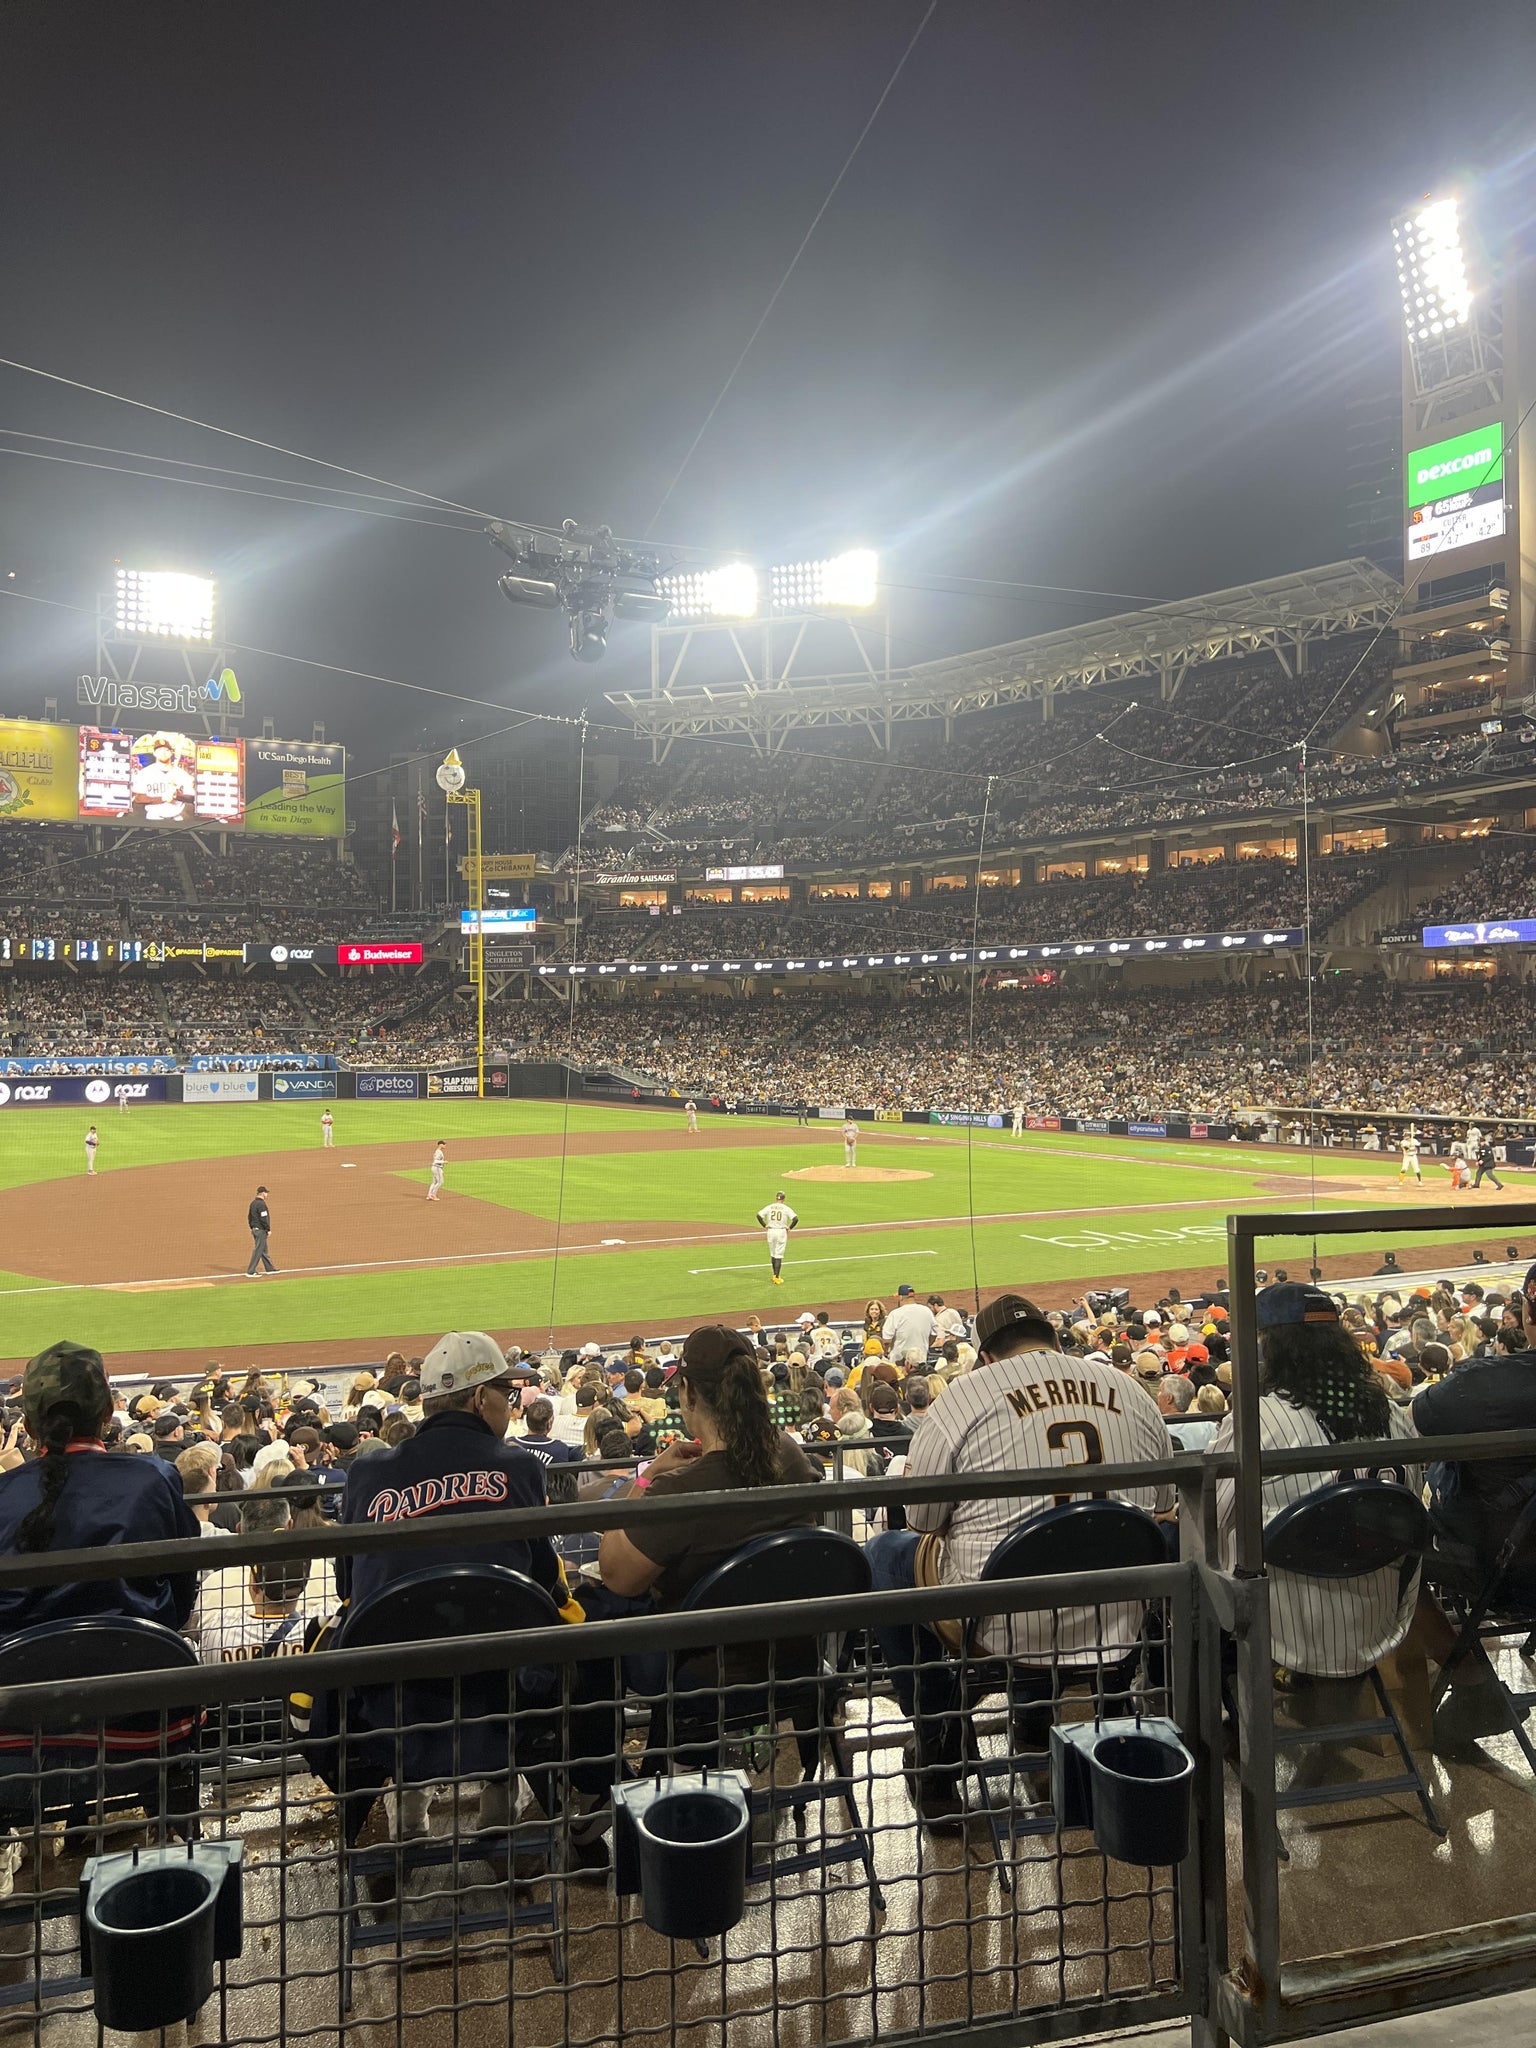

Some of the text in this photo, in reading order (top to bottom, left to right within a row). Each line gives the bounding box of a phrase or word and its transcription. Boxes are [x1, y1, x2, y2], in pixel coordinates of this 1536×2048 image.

[82, 675, 196, 713] Viasat
[258, 751, 331, 765] UC San Diego Health
[284, 771, 304, 779] BEST
[260, 801, 336, 816] Leading the Way
[260, 813, 312, 825] in San Diego
[595, 873, 675, 884] Tarantino SAUSAGES
[20, 944, 26, 955] F
[64, 945, 70, 956] F
[107, 946, 114, 956] F
[290, 949, 314, 959] razr
[363, 950, 412, 959] Budweiser
[186, 1080, 246, 1092] blue blue
[289, 1080, 335, 1089] VANDA
[376, 1077, 414, 1091] petco
[443, 1077, 461, 1086] SLAP
[15, 1085, 51, 1100] razr
[443, 1084, 463, 1092] CHEESE
[464, 1084, 473, 1092] ON
[770, 1211, 782, 1221] 20
[1020, 1225, 1228, 1248] blue
[1006, 1379, 1122, 1420] MERRILL
[367, 1471, 508, 1523] PADRES
